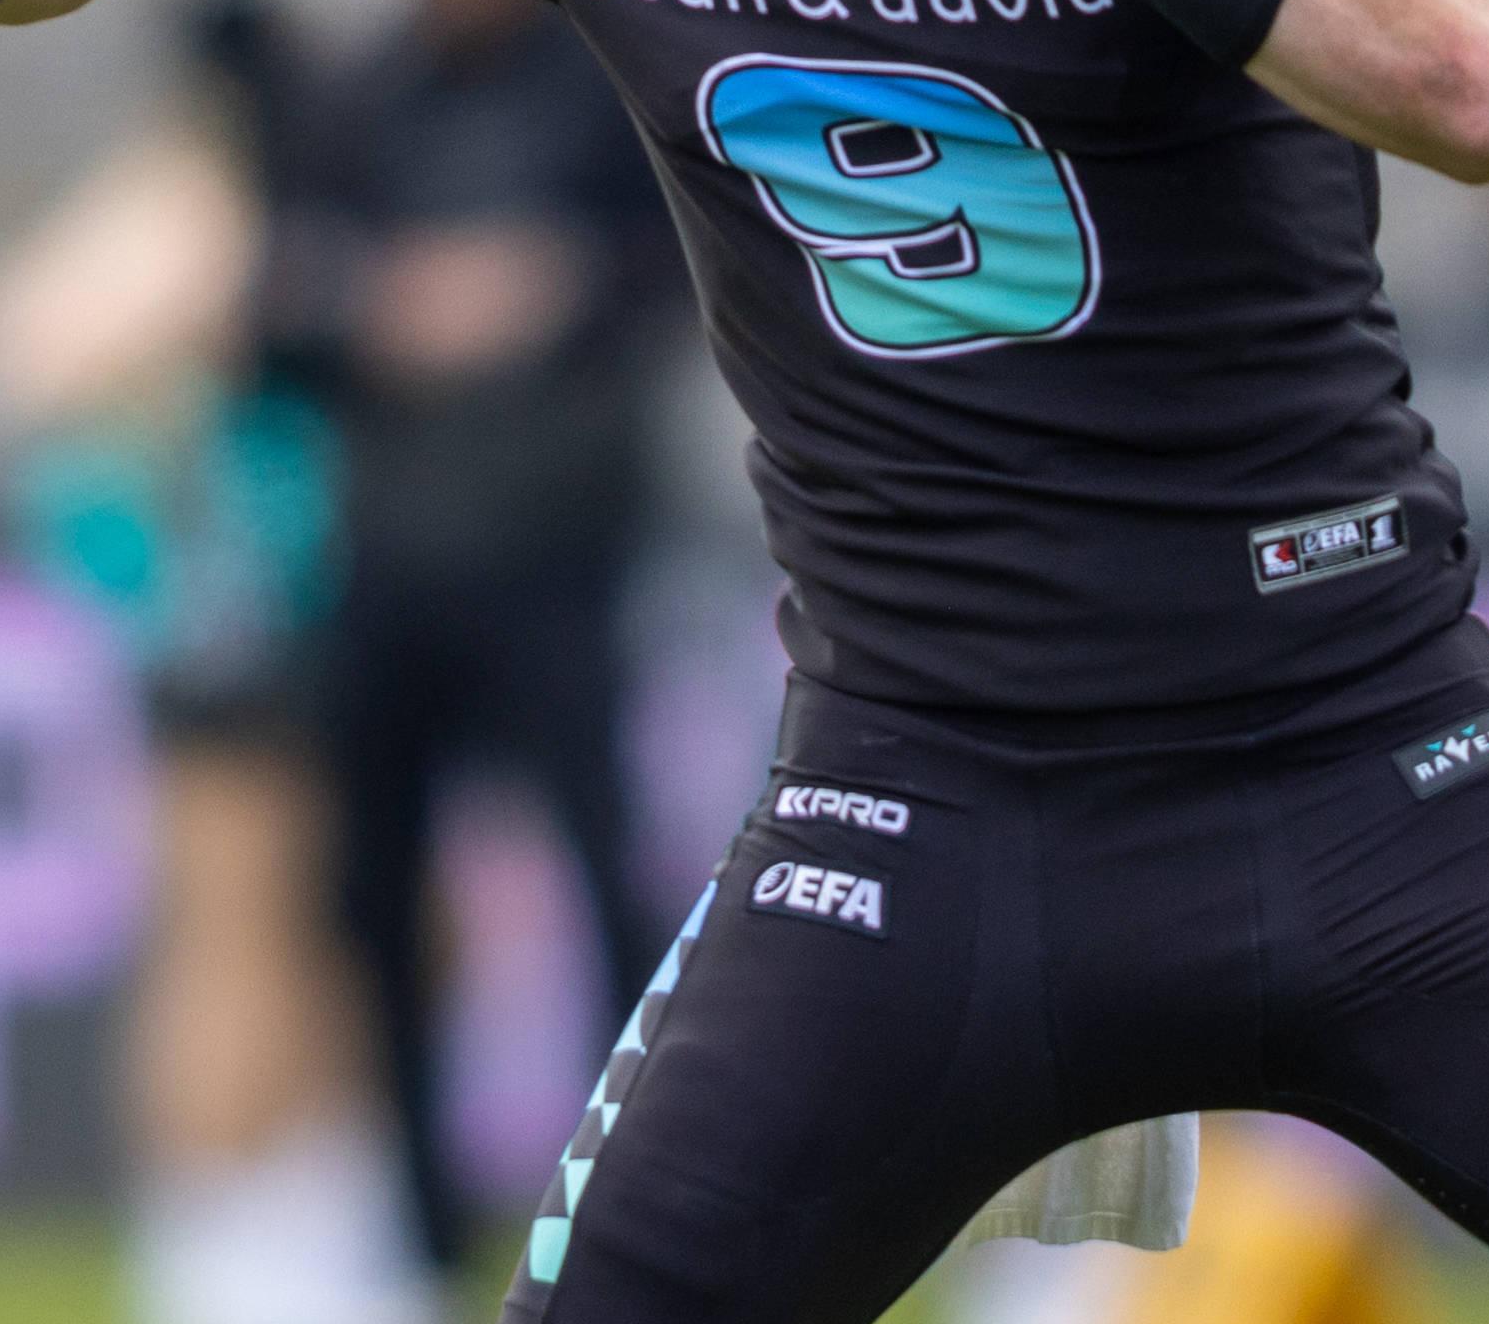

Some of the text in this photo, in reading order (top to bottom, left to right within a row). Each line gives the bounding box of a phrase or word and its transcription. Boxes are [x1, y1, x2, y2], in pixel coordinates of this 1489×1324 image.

[695, 52, 1102, 360] 9
[775, 785, 910, 834] KPRO
[785, 863, 883, 929] EFA
